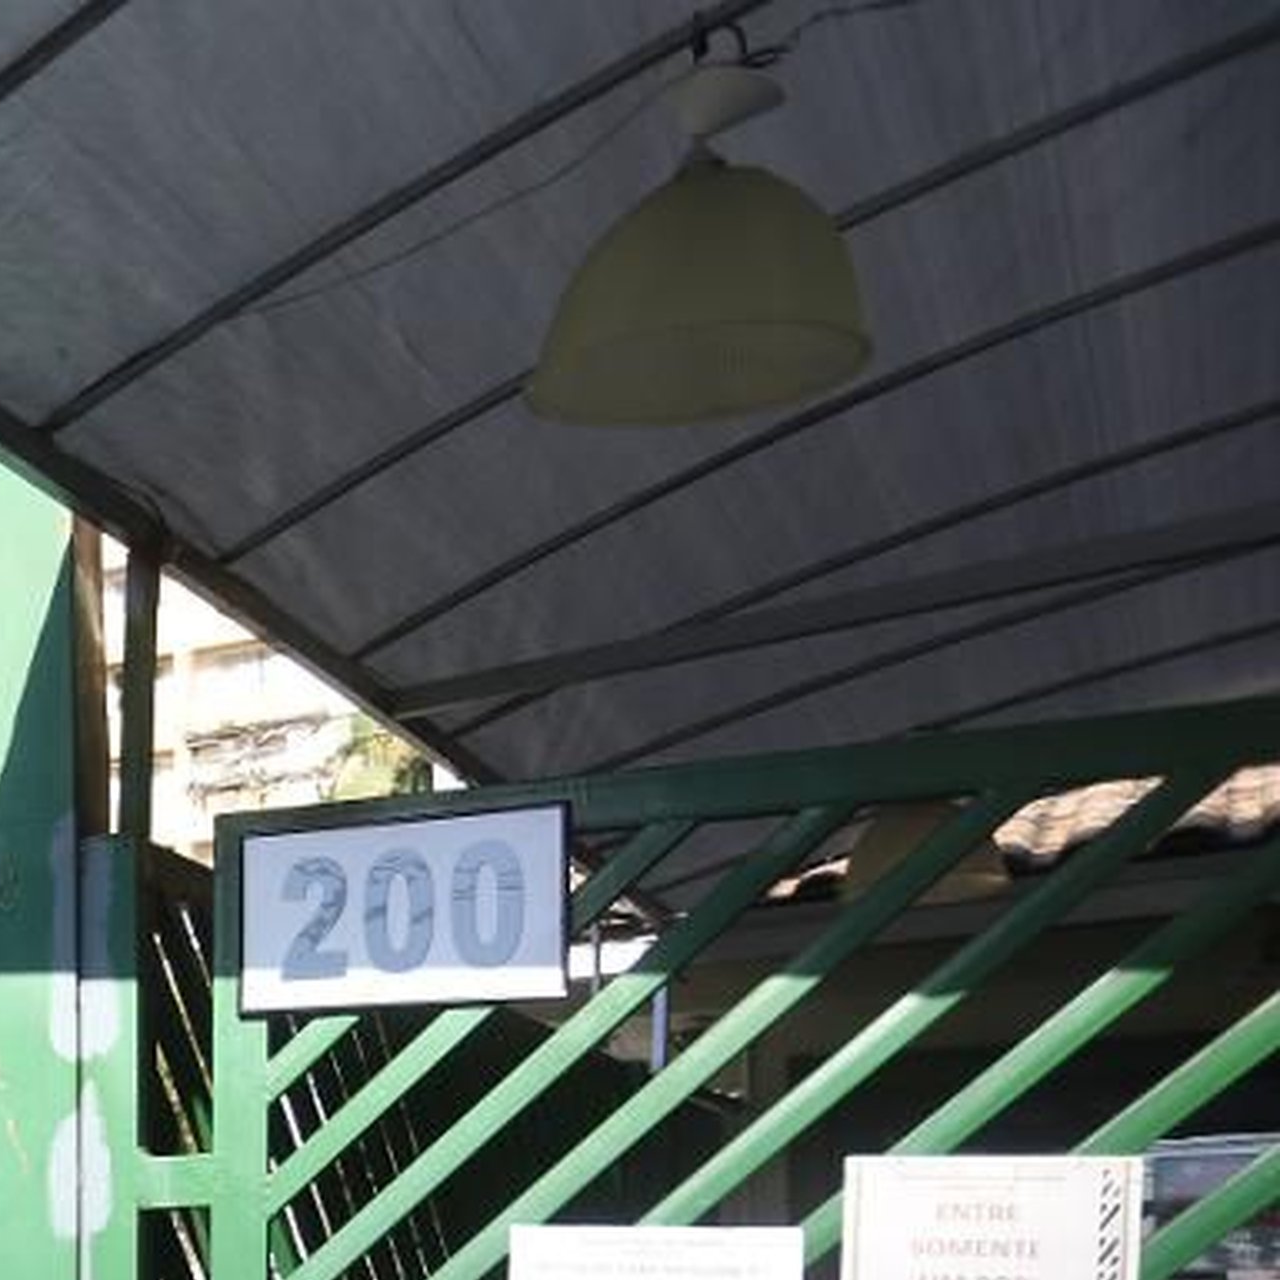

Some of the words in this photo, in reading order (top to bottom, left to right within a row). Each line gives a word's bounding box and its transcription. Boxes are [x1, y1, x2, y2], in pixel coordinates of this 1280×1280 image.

[280, 837, 526, 981] 200
[935, 1201, 1020, 1222] ENTRE
[910, 1237, 1040, 1258] SOMENTE
